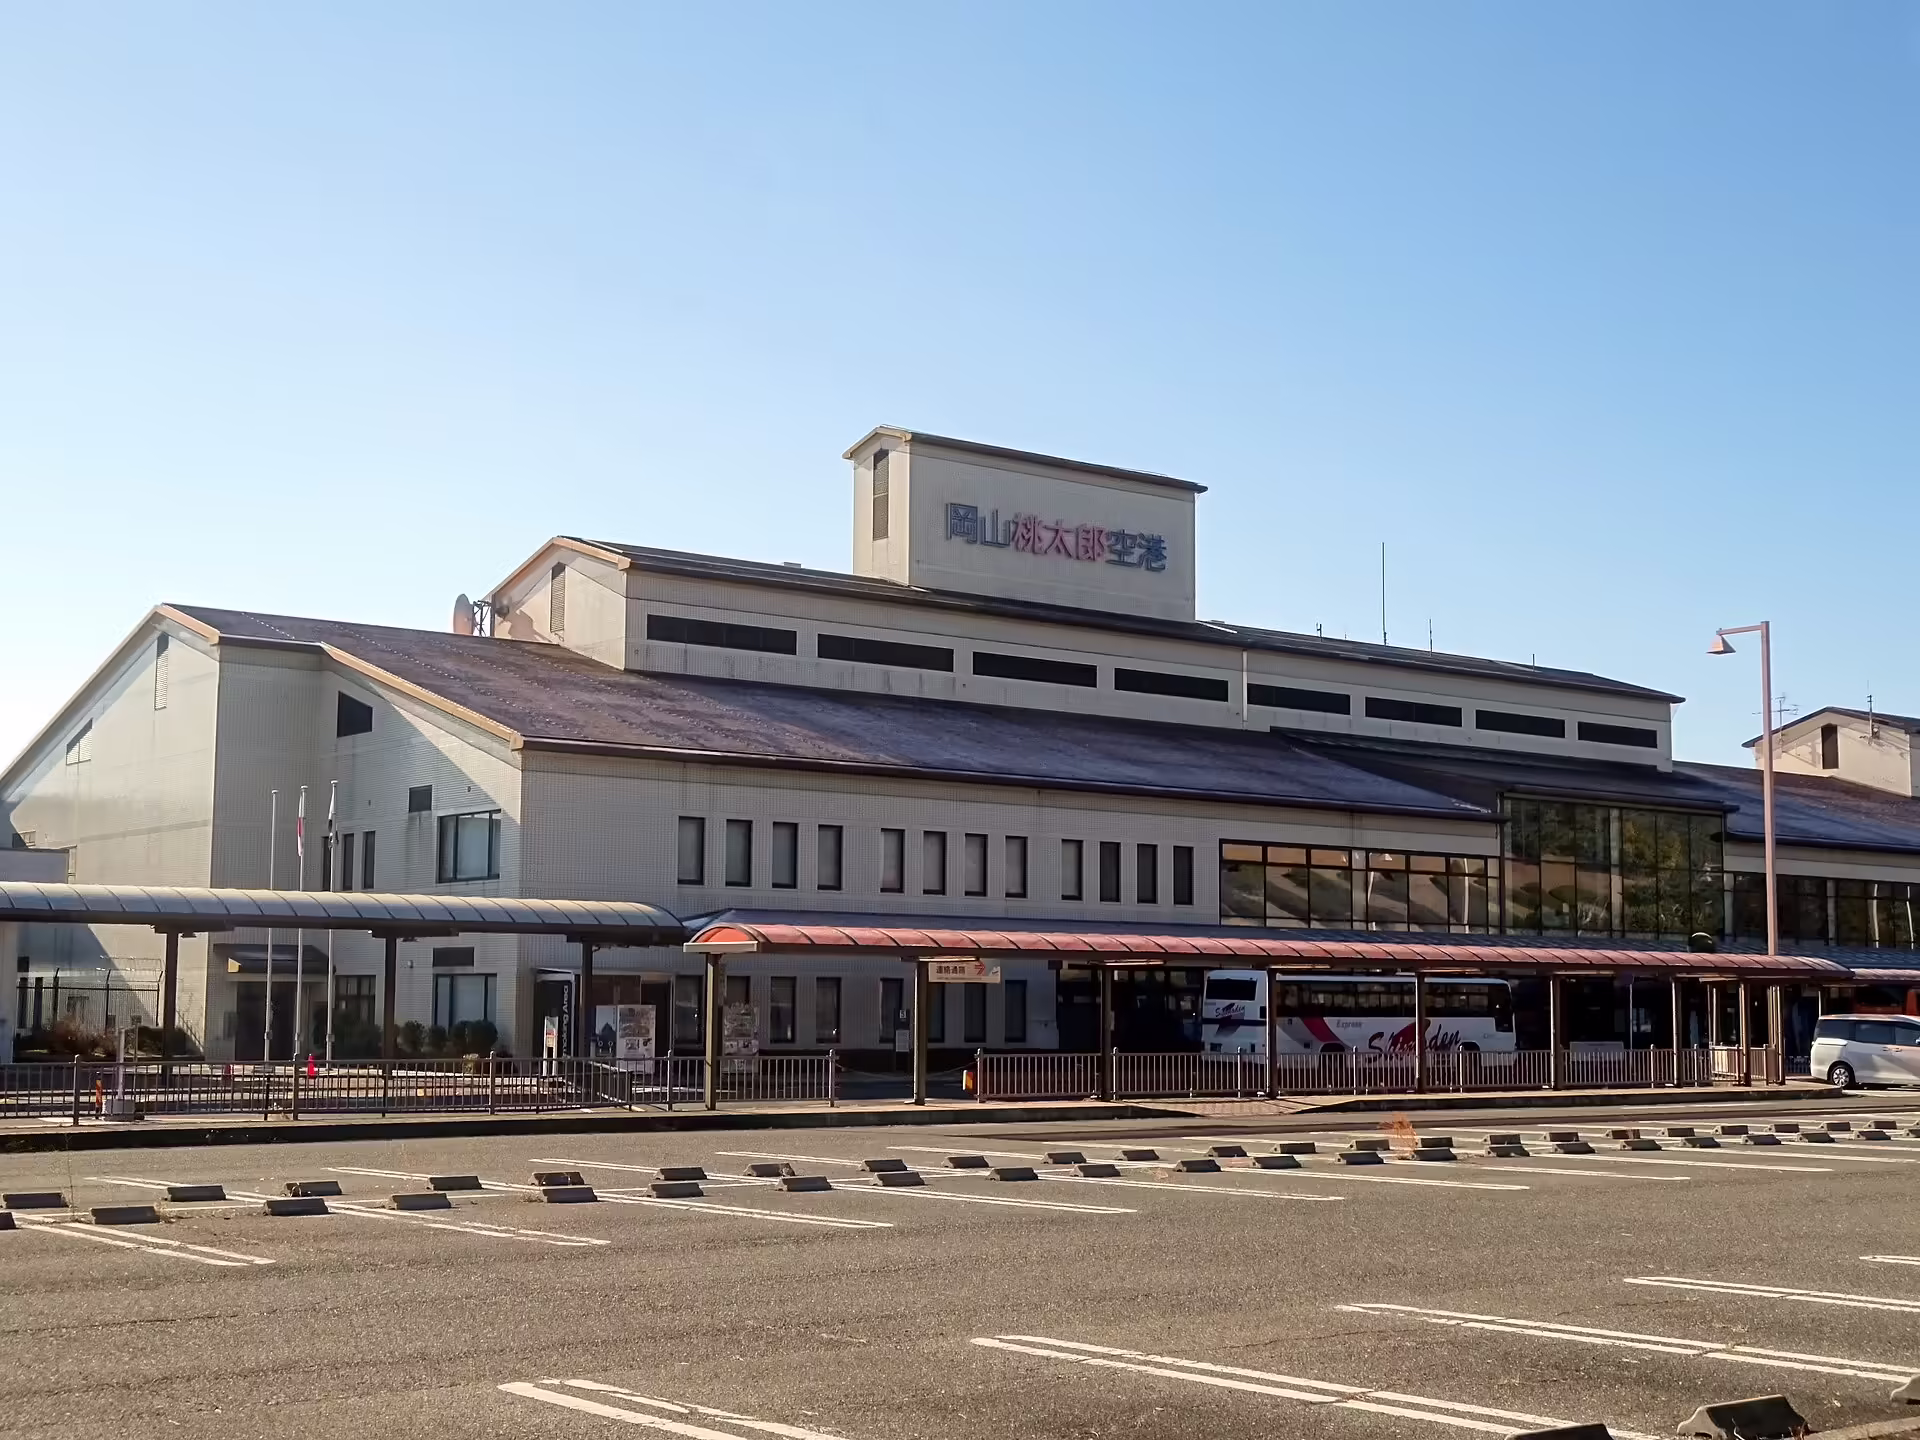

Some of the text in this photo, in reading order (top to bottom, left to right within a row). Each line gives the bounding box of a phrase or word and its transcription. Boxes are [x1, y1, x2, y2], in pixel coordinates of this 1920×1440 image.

[946, 502, 1167, 572] 岡山桃太郎空港
[1366, 1023, 1461, 1063] Shimden
